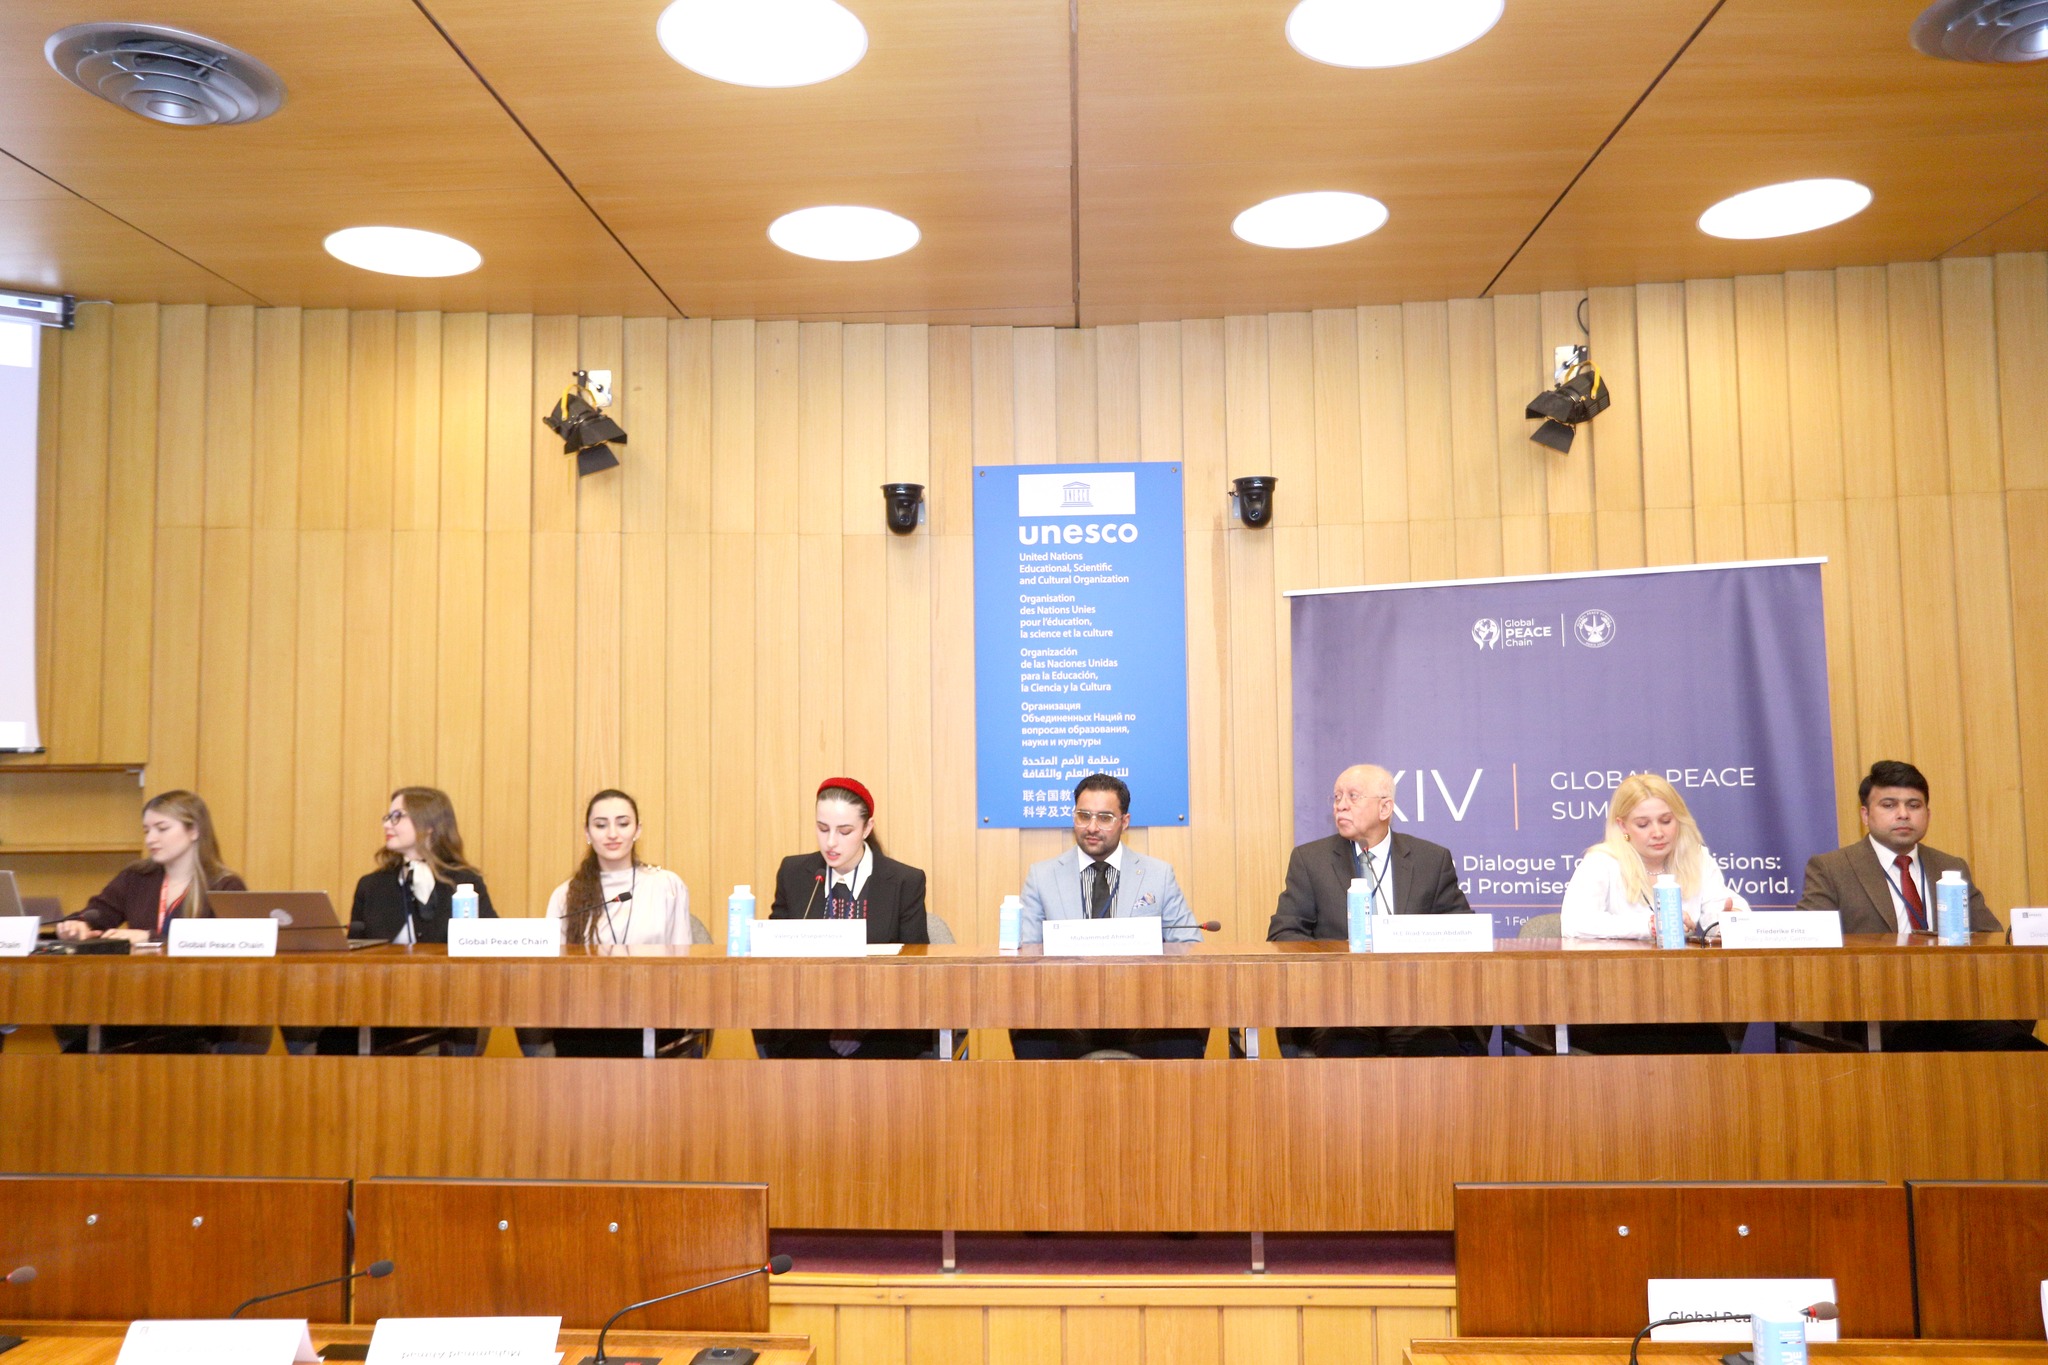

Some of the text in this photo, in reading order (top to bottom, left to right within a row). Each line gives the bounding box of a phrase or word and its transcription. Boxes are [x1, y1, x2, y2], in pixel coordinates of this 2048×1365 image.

[1019, 523, 1138, 545] unesco
[1019, 552, 1083, 561] United Nations
[1019, 563, 1112, 573] Educational, Scientific
[1019, 575, 1129, 585] and Cultural Organization
[1020, 594, 1075, 605] Organisation
[1020, 605, 1095, 615] des Nations Unies
[1020, 619, 1041, 628] pour
[1504, 618, 1534, 627] Global
[1020, 629, 1113, 638] la science et la culture
[1506, 626, 1552, 638] PEACE
[1506, 639, 1532, 647] Chain
[1021, 648, 1078, 659] Organización
[1021, 659, 1118, 669] de las Naciones Unidas
[1021, 671, 1098, 682] para la Educación,
[1021, 682, 1111, 693] la Ciencia y la Cultura
[1021, 702, 1081, 712] Организация
[1022, 714, 1091, 723] Объединенных
[1094, 713, 1122, 723] Наций
[1022, 725, 1129, 736] вопросам образования,
[1022, 738, 1048, 748] науки
[1058, 738, 1101, 748] культуры
[1022, 755, 1120, 768] منظمة الأمم المتحدة
[1022, 769, 1061, 780] والثقافة
[1550, 767, 1756, 790] GLOB PEACE
[1022, 789, 1074, 802] 联合国教
[1552, 801, 1608, 820] SUM
[1464, 854, 1556, 874] Dialogue
[1712, 852, 1781, 870] isions:
[1726, 877, 1795, 894] World.
[1505, 916, 1510, 926] 1
[178, 940, 265, 949] Global Peace Chain
[1723, 1311, 1751, 1323] Pea
